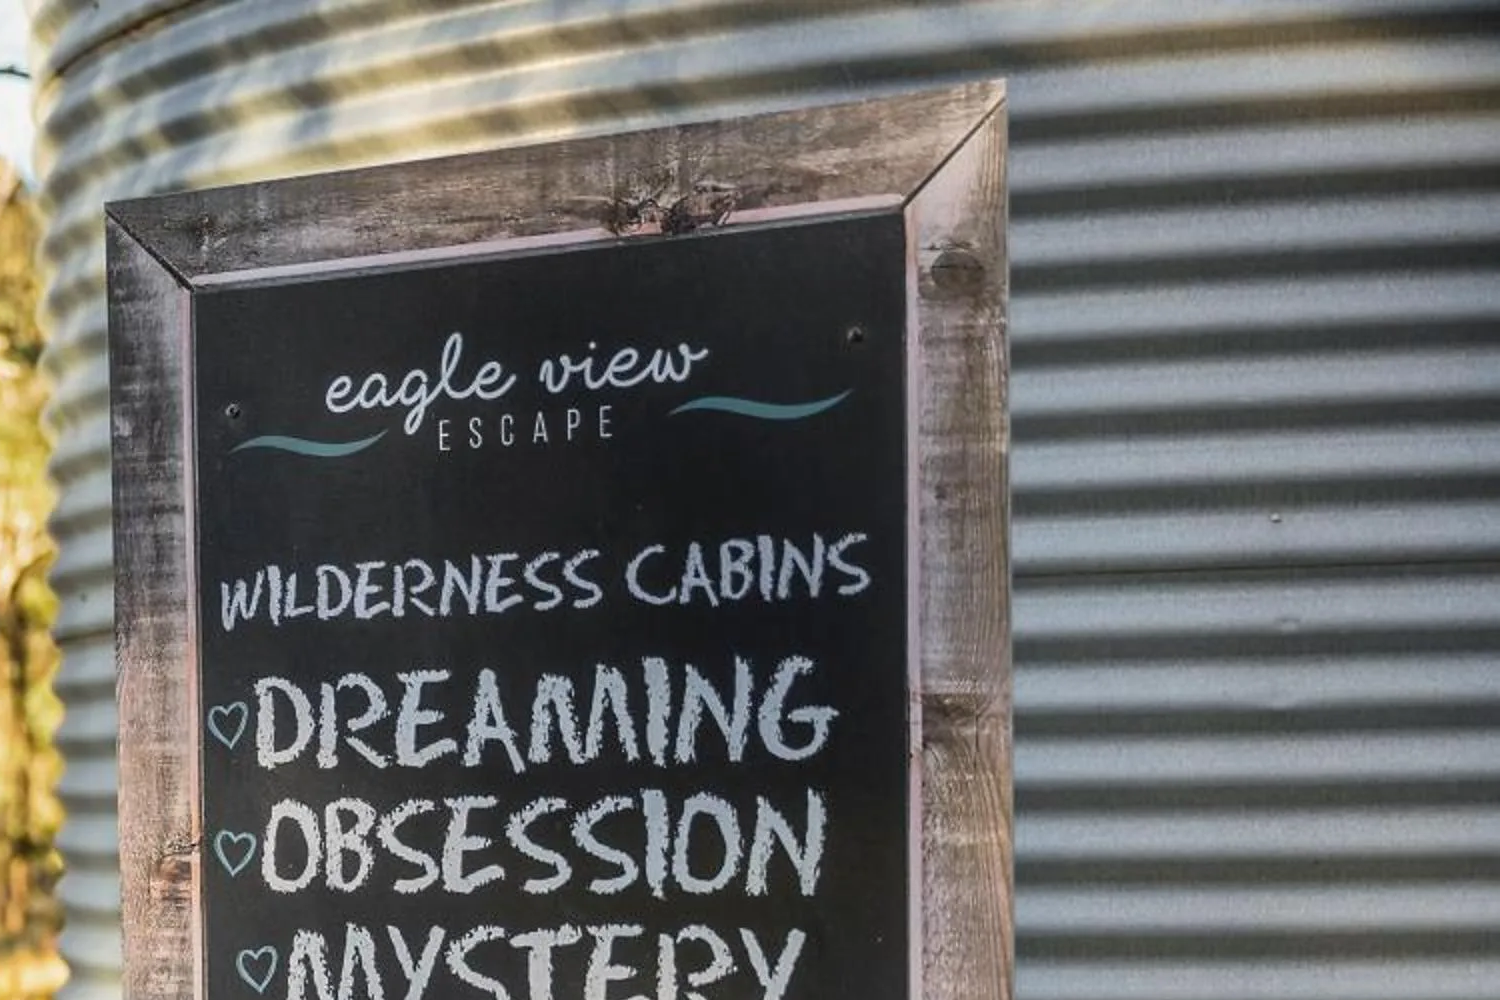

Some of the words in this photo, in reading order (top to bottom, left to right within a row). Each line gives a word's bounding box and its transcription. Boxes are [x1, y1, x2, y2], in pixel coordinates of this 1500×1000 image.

[324, 332, 517, 436] eagle
[538, 339, 710, 393] view
[437, 405, 614, 452] ESCAPE
[220, 548, 604, 632] WILDERNESS
[626, 533, 871, 606] CABINS
[253, 655, 840, 774] DREAMING
[261, 787, 827, 899] OBSESSION
